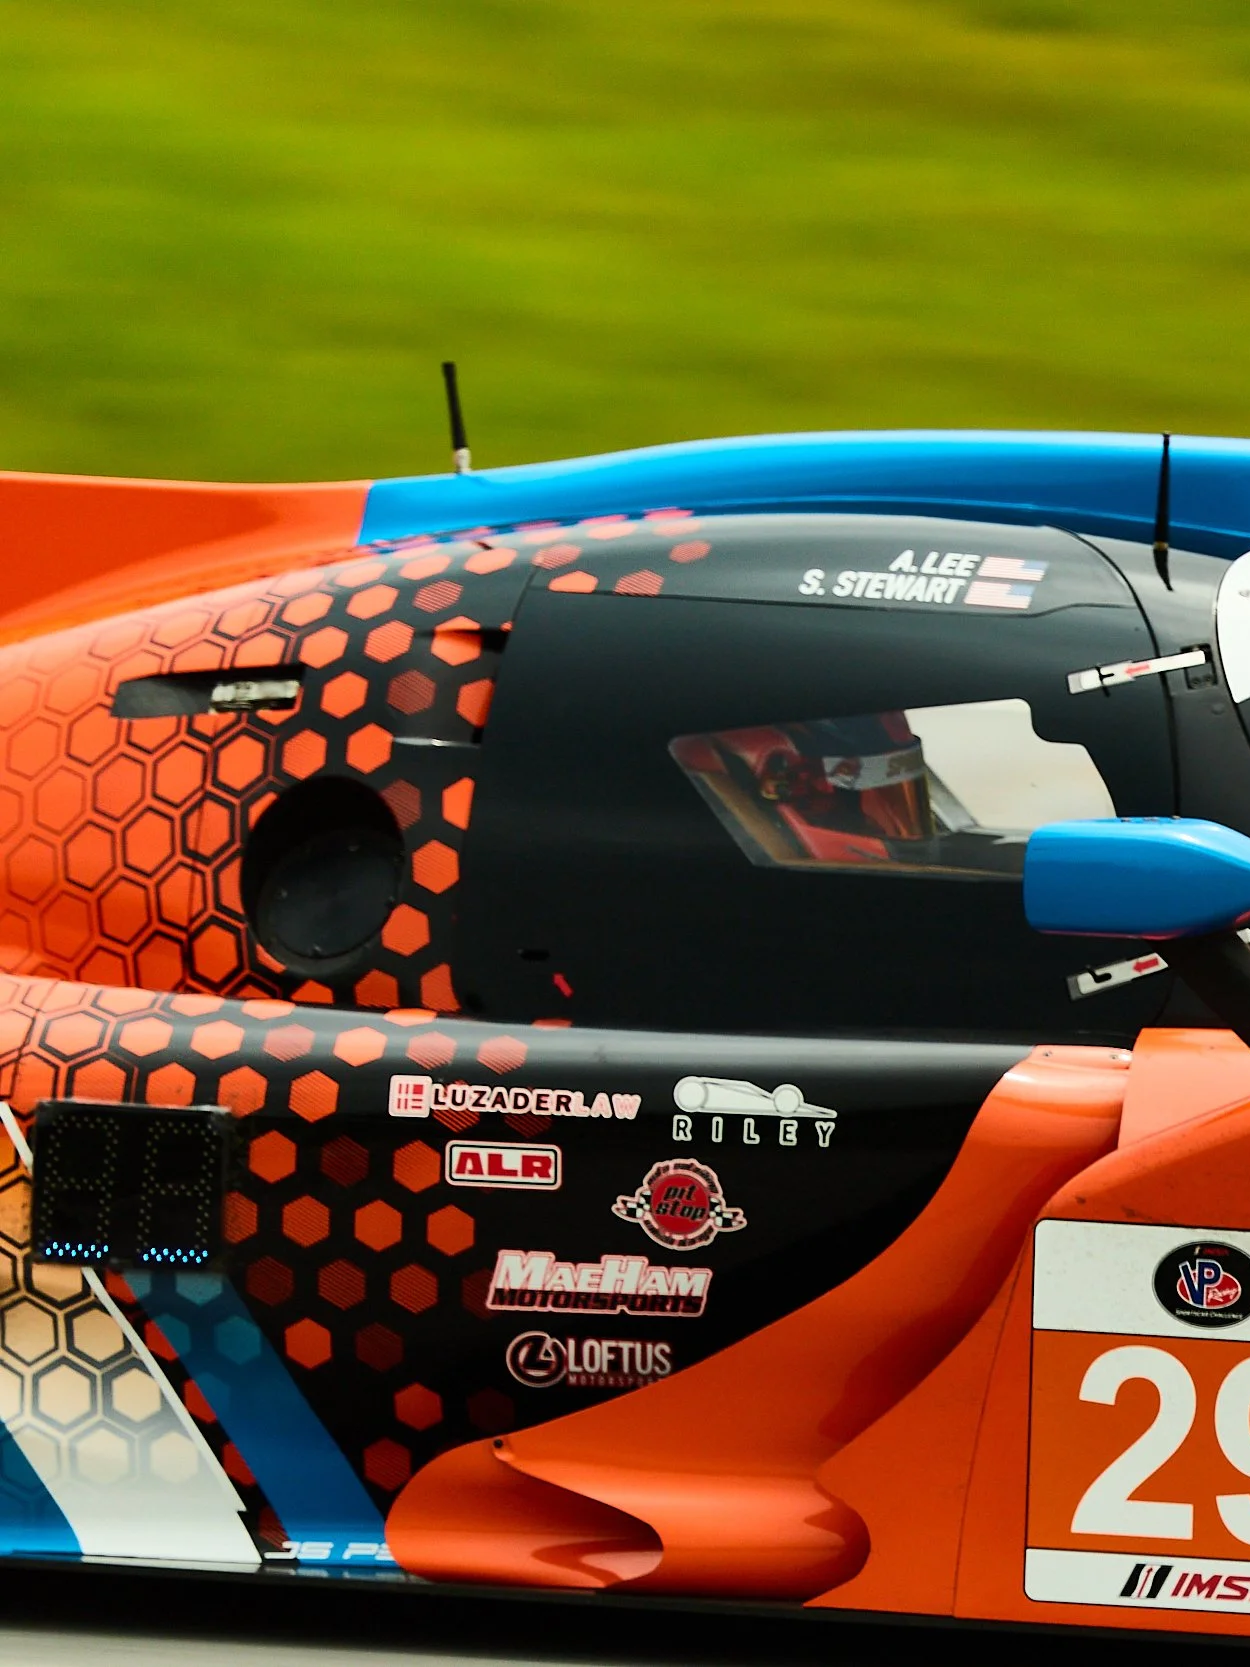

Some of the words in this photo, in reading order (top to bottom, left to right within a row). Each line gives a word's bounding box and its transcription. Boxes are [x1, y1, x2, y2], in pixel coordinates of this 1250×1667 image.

[798, 568, 825, 596] S.
[832, 570, 967, 604] STEWART
[672, 1114, 836, 1148] RILEY
[455, 1152, 552, 1179] ALR
[664, 1185, 697, 1201] pit
[655, 1200, 706, 1221] stop
[1178, 1258, 1223, 1308] VP
[490, 1288, 704, 1313] MOTORSPORTS
[567, 1338, 672, 1375] LOFTUS
[264, 1541, 334, 1560] JS
